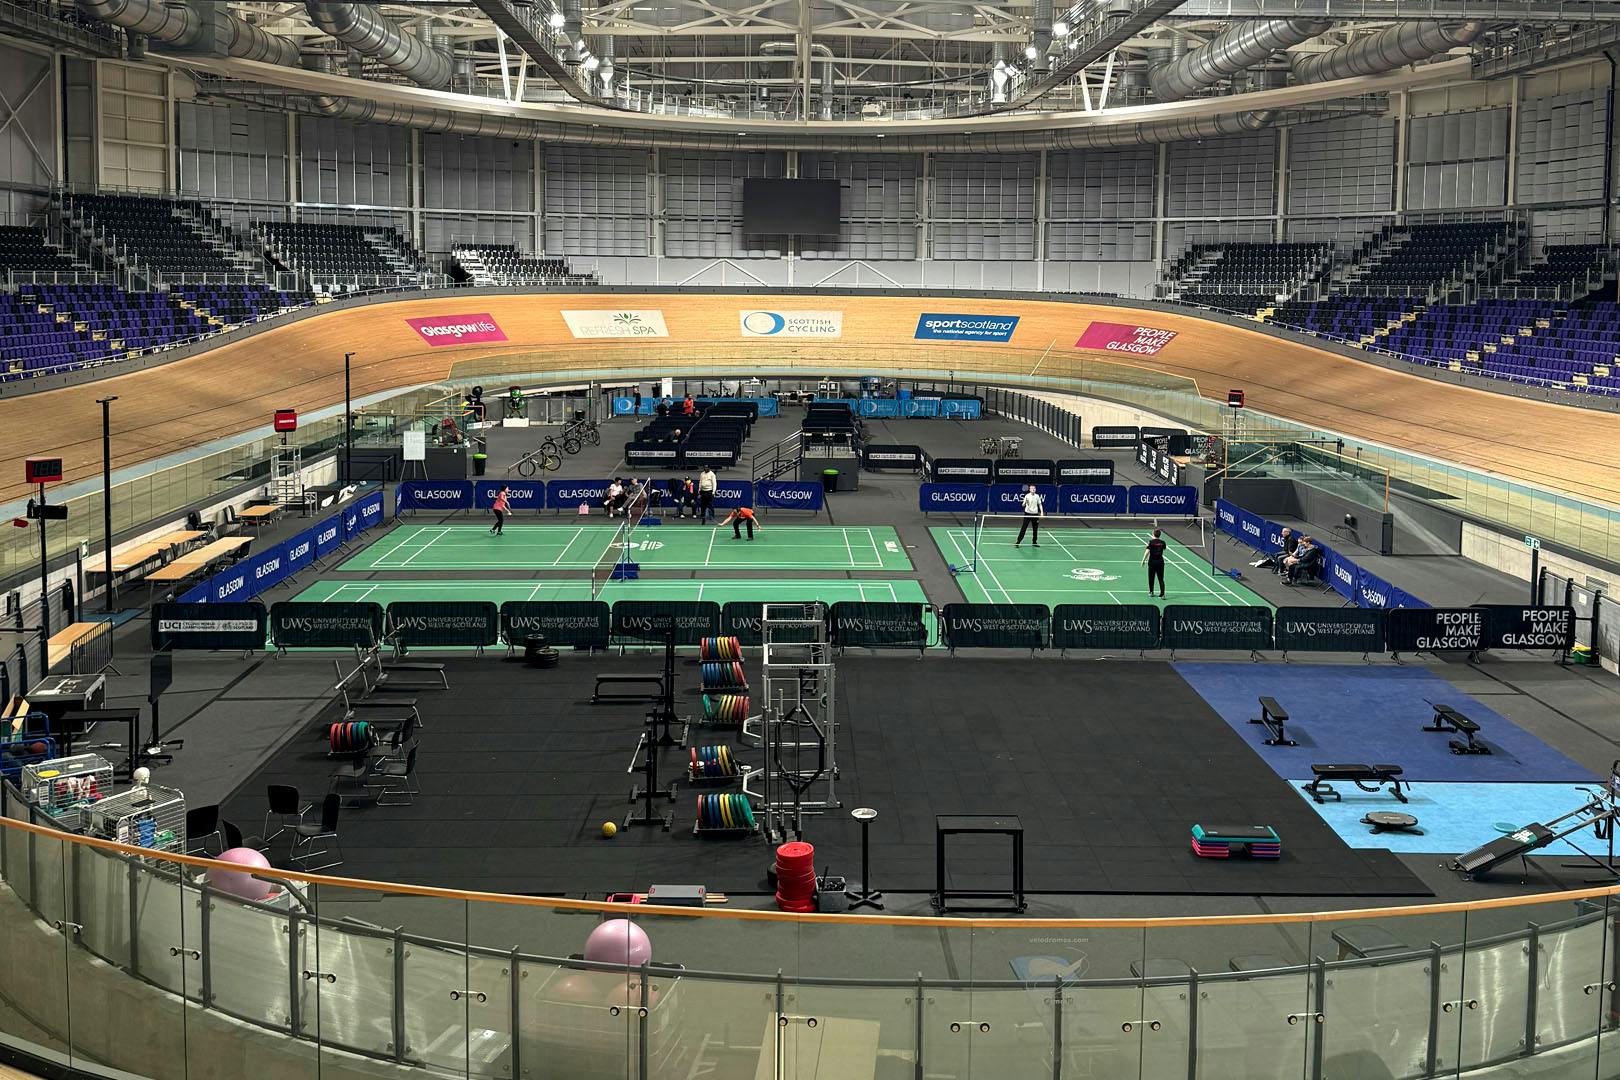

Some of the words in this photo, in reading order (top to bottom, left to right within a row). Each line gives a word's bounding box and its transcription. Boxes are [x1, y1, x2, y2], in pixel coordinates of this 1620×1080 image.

[632, 326, 657, 335] SPA
[925, 320, 1013, 330] sportscotland
[1133, 327, 1176, 340] PEOPLE
[1106, 341, 1160, 355] GLASGOW
[1134, 336, 1169, 348] MAKE
[414, 490, 462, 499] GLASGOW
[488, 490, 534, 498] GLSGOW
[559, 490, 605, 498] GLASGOW
[770, 490, 812, 500] GLASGOW
[931, 492, 976, 502] GLASGOW
[1070, 494, 1116, 503] GLASGOW
[1140, 494, 1186, 504] GLASGOW
[362, 502, 380, 518] GLASGOW
[1242, 520, 1260, 538] GLASGOW
[318, 527, 336, 545] GLASGOW
[1271, 533, 1285, 547] GLAS
[290, 542, 310, 560] GLASGOW
[256, 558, 280, 579] GLASGOW
[1334, 564, 1354, 587] GLASGOW
[218, 576, 244, 599] GLASGOW
[1436, 612, 1482, 624] PEOPLE
[1522, 610, 1570, 622] PEOPLE
[282, 618, 312, 631] UWS
[510, 616, 540, 630] UWS
[622, 616, 652, 630] UWS
[732, 618, 761, 632] UWS
[838, 618, 863, 632] UWS
[953, 618, 982, 632] UWS
[1064, 620, 1092, 634] UWS
[1174, 620, 1203, 634] UWS
[1287, 622, 1316, 636] UWS
[1532, 622, 1568, 634] MAKE
[1445, 625, 1481, 636] MAKE
[1416, 636, 1480, 648] GLASGOW
[1502, 634, 1568, 645] GLASGOW
